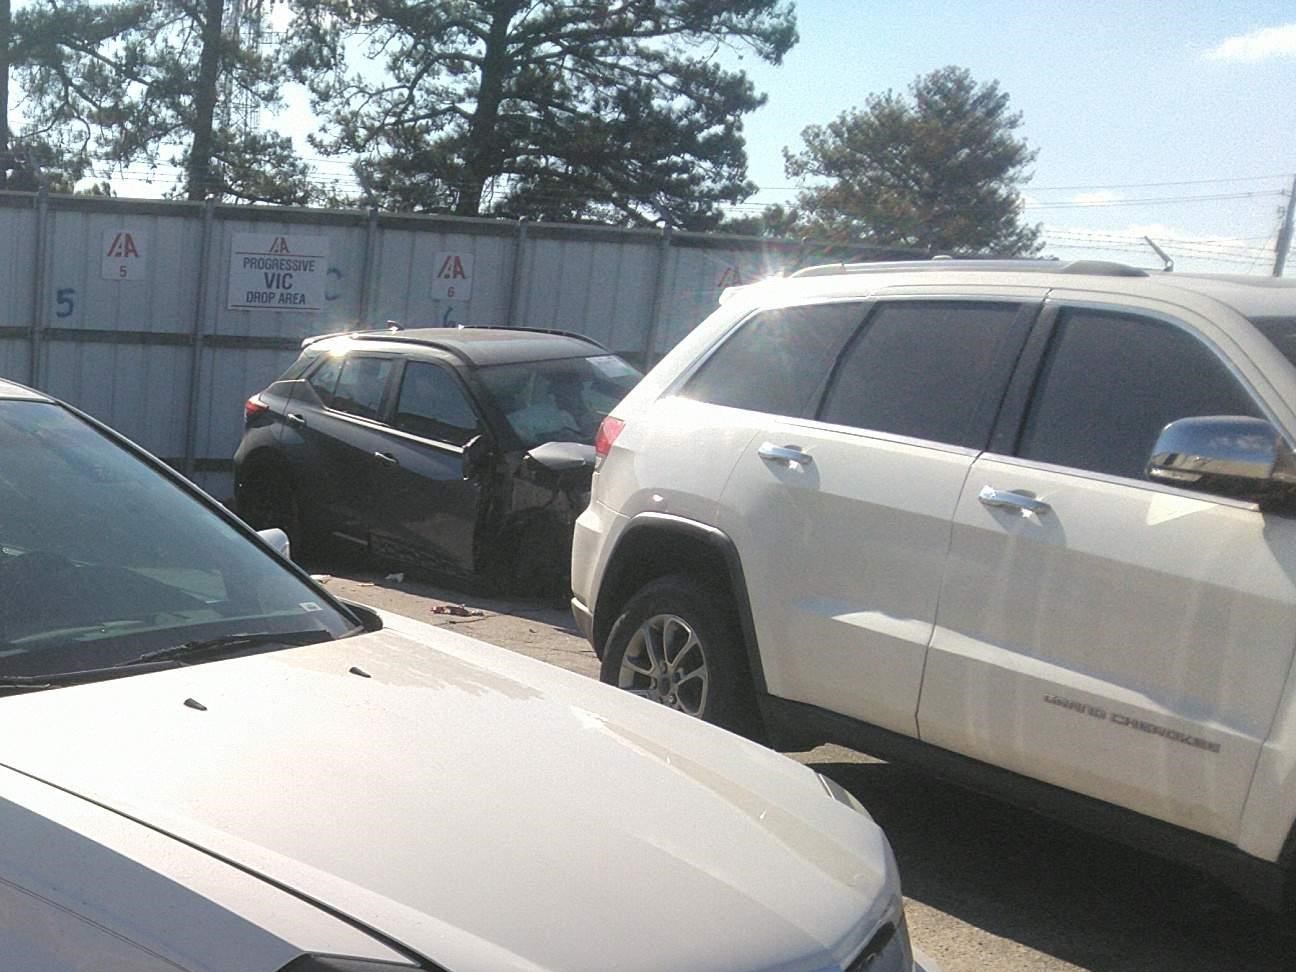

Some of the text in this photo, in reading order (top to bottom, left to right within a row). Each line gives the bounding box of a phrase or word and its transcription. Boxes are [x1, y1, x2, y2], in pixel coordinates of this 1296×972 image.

[119, 265, 129, 278] 5
[243, 257, 317, 273] PROGRESSIVE
[264, 272, 294, 290] VIC
[246, 291, 306, 305] DROP AREA
[447, 286, 455, 298] 6
[55, 287, 76, 318] 5
